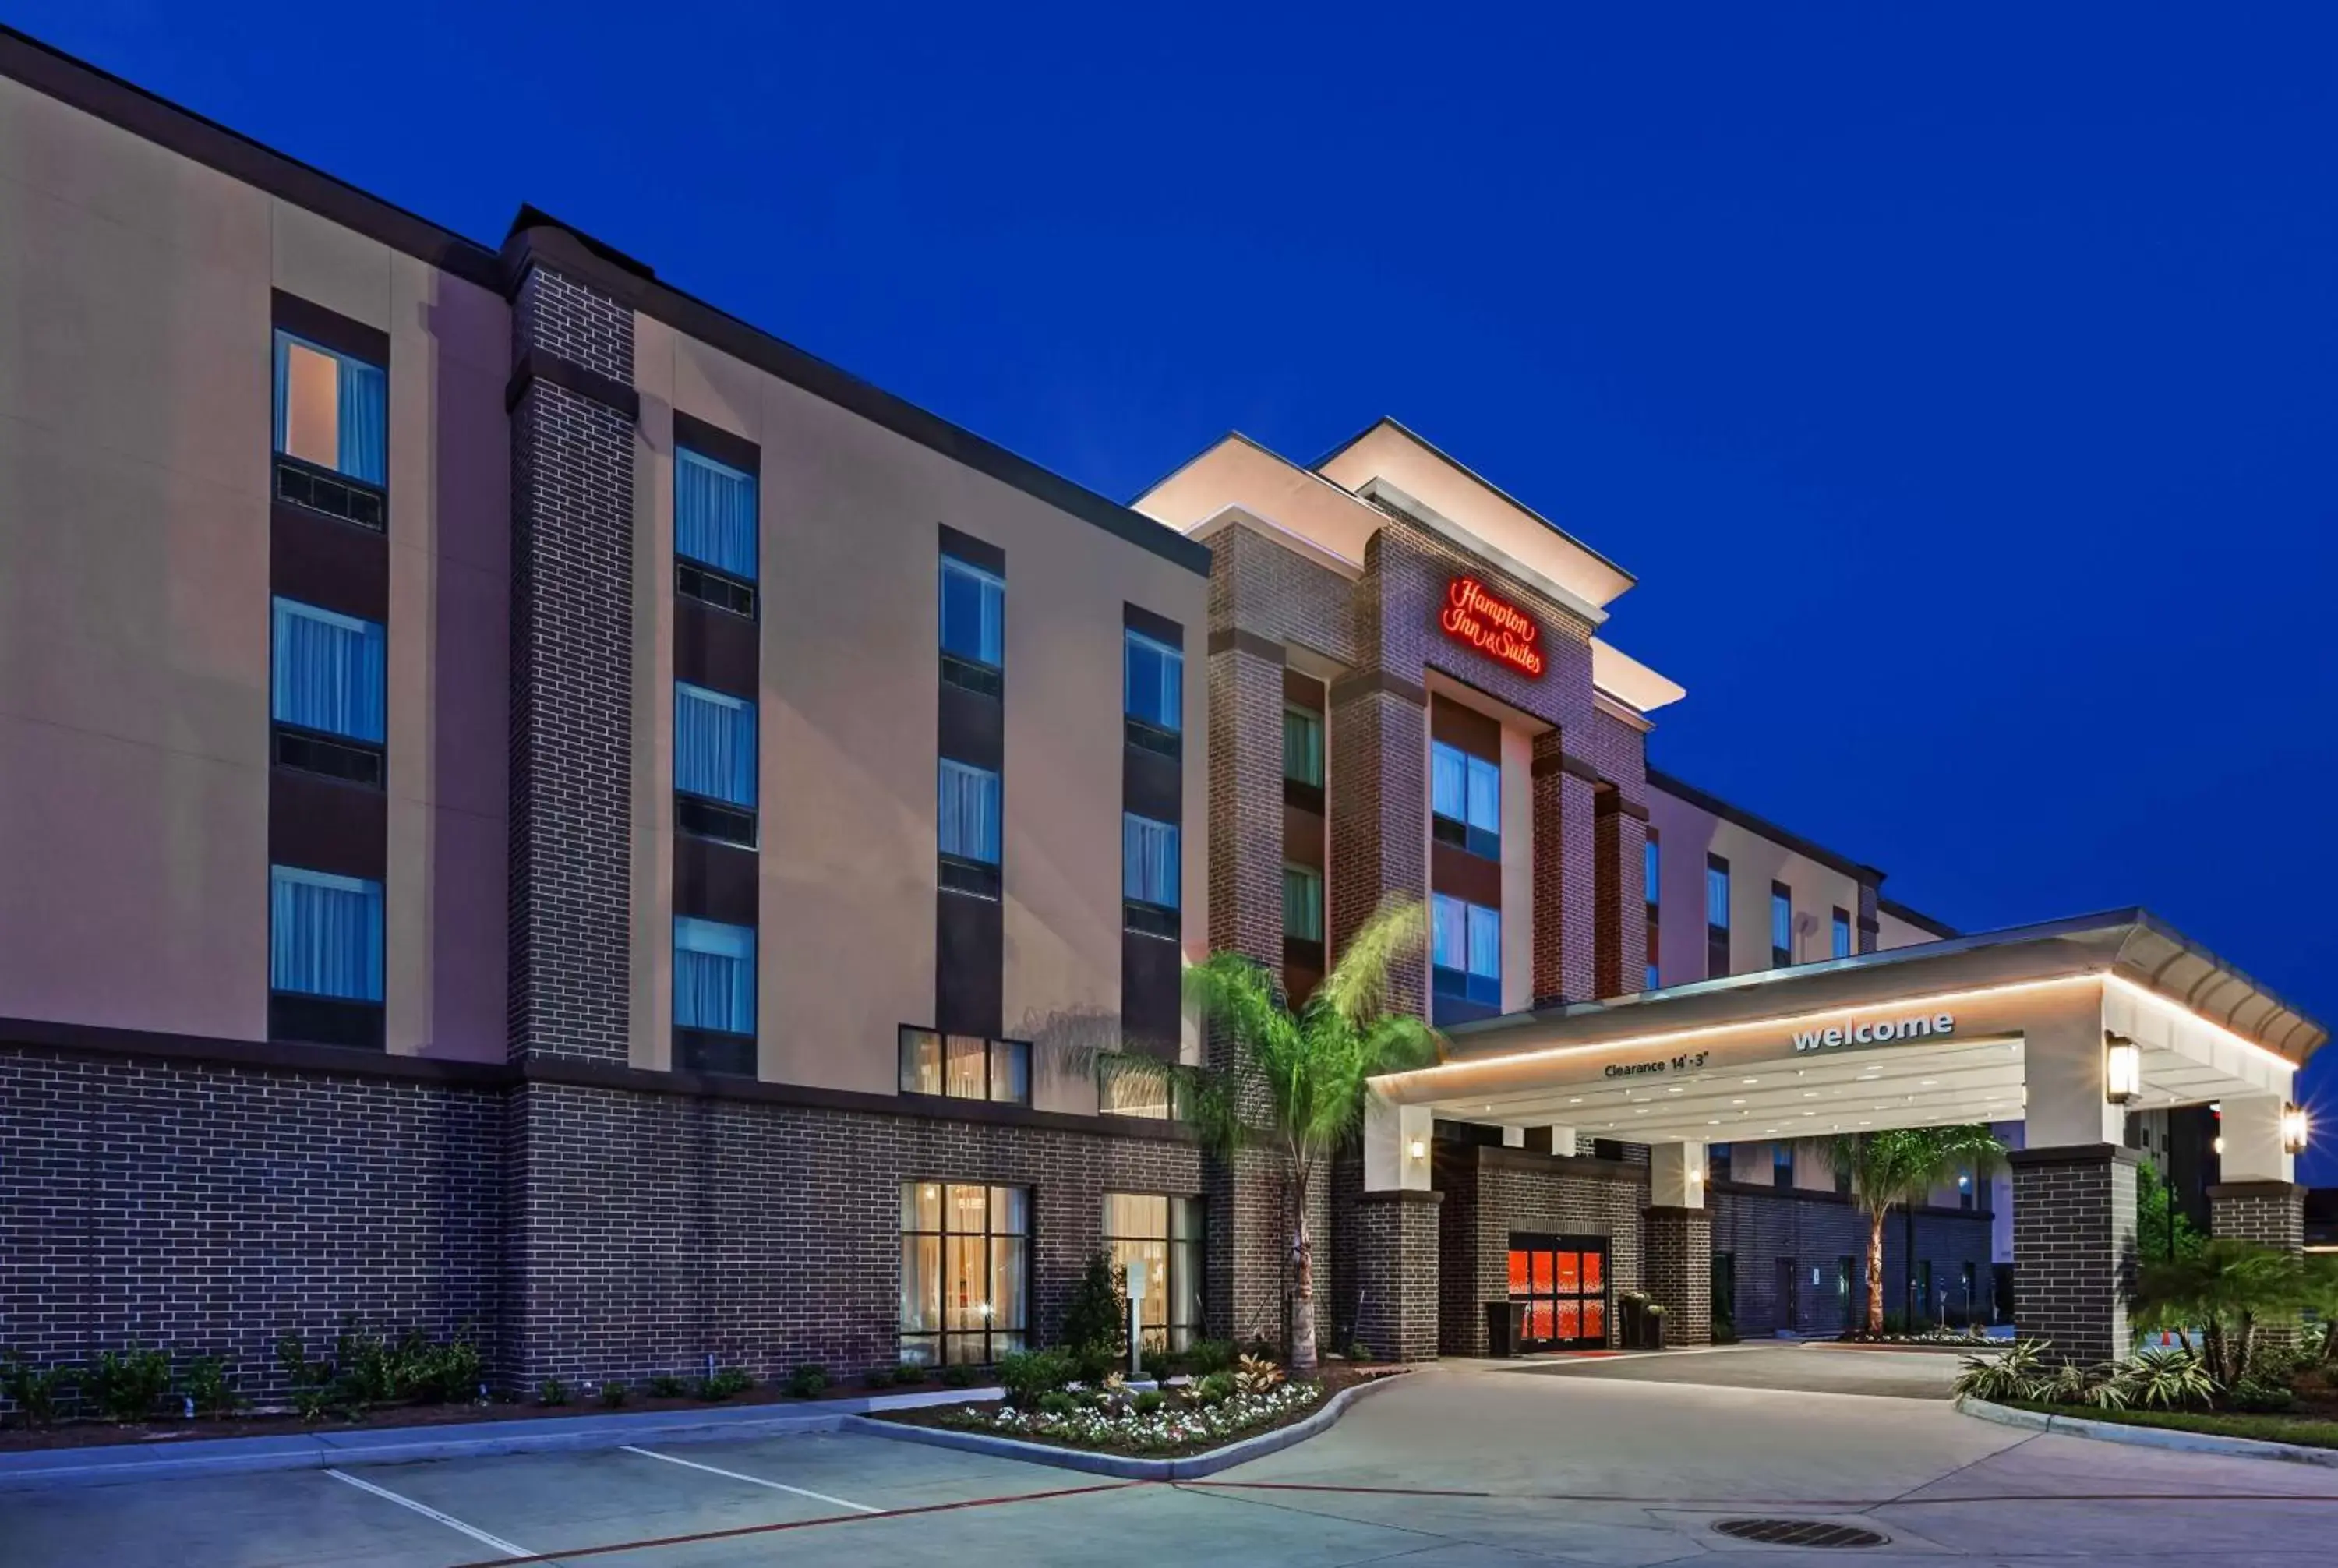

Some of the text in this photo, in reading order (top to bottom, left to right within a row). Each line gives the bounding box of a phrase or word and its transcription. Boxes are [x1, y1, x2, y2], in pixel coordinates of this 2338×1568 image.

[1450, 579, 1535, 643] Hampton
[1442, 608, 1542, 674] Inn & Suites
[1793, 1011, 1955, 1051] welcome
[1605, 1060, 1665, 1077] Clearance
